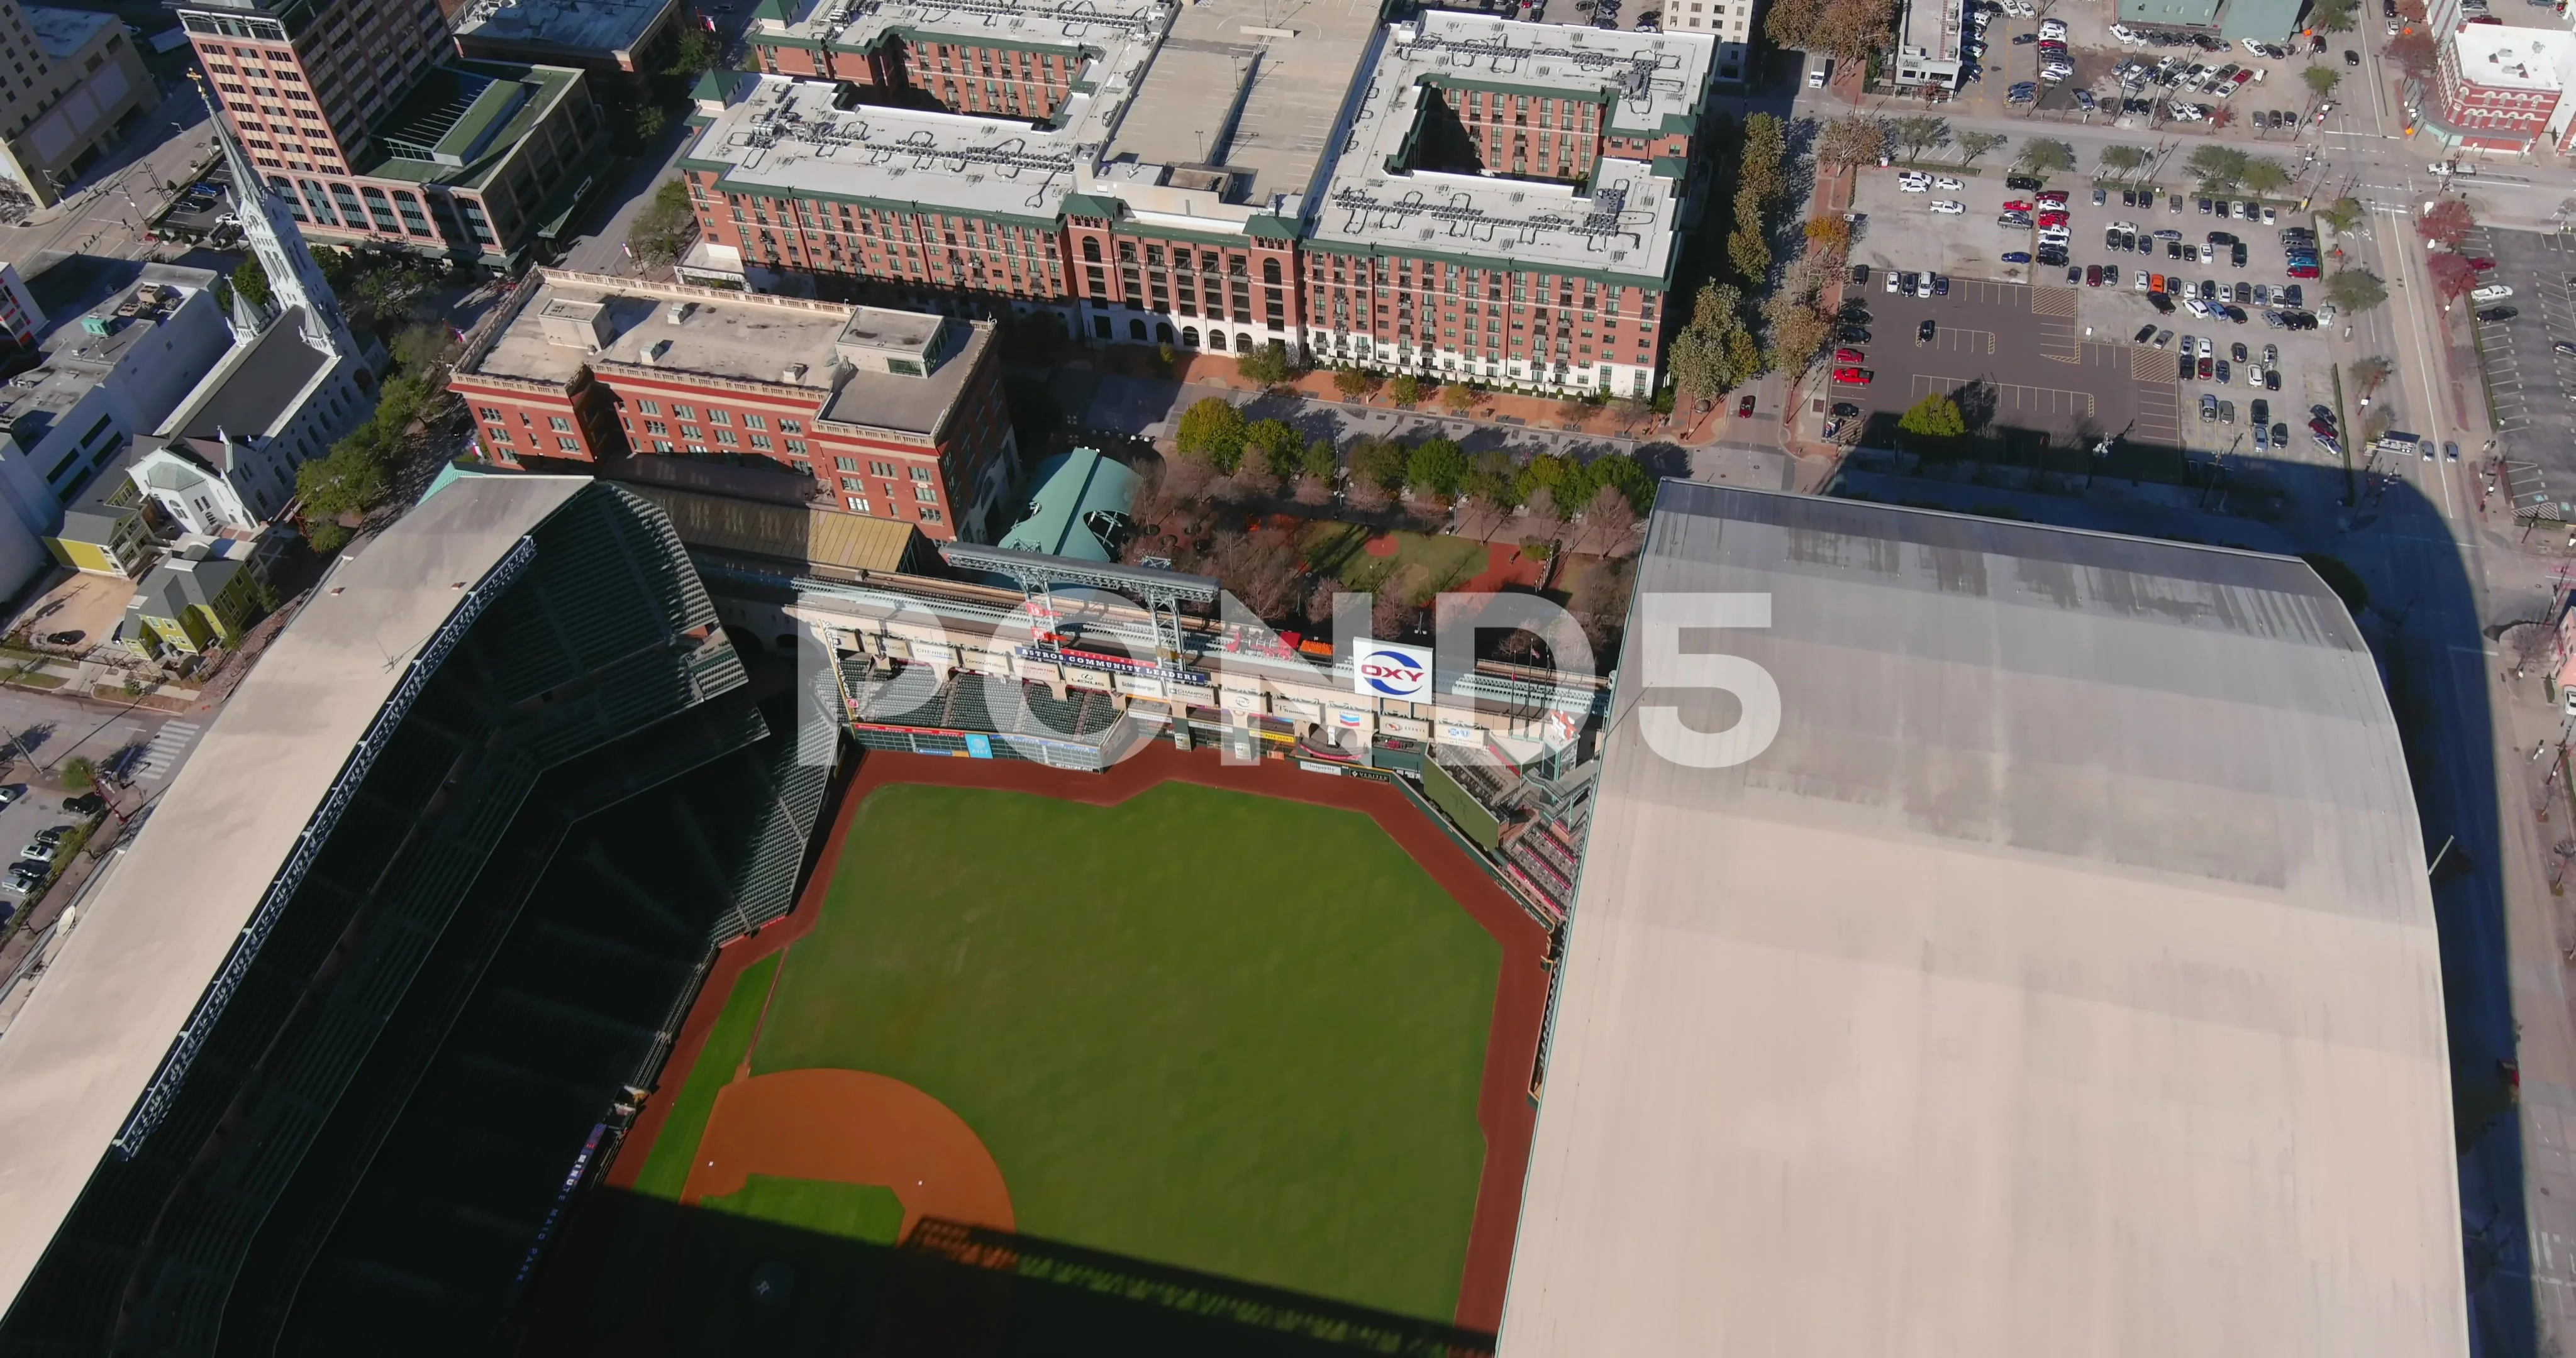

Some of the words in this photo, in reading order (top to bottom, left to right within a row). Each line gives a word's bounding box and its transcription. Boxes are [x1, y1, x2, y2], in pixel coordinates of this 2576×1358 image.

[916, 648, 953, 657] CHENIERE
[1022, 648, 1064, 660] ASTROS
[1069, 656, 1140, 672] COMMUNITY
[1146, 668, 1197, 681] LEADERS
[1072, 678, 1104, 687] LEXUS
[1361, 665, 1424, 682] OXY
[1177, 689, 1211, 698] CHAMPION
[558, 1154, 587, 1201] MINUTE
[538, 1208, 558, 1240] MAID
[516, 1248, 538, 1281] PARK
